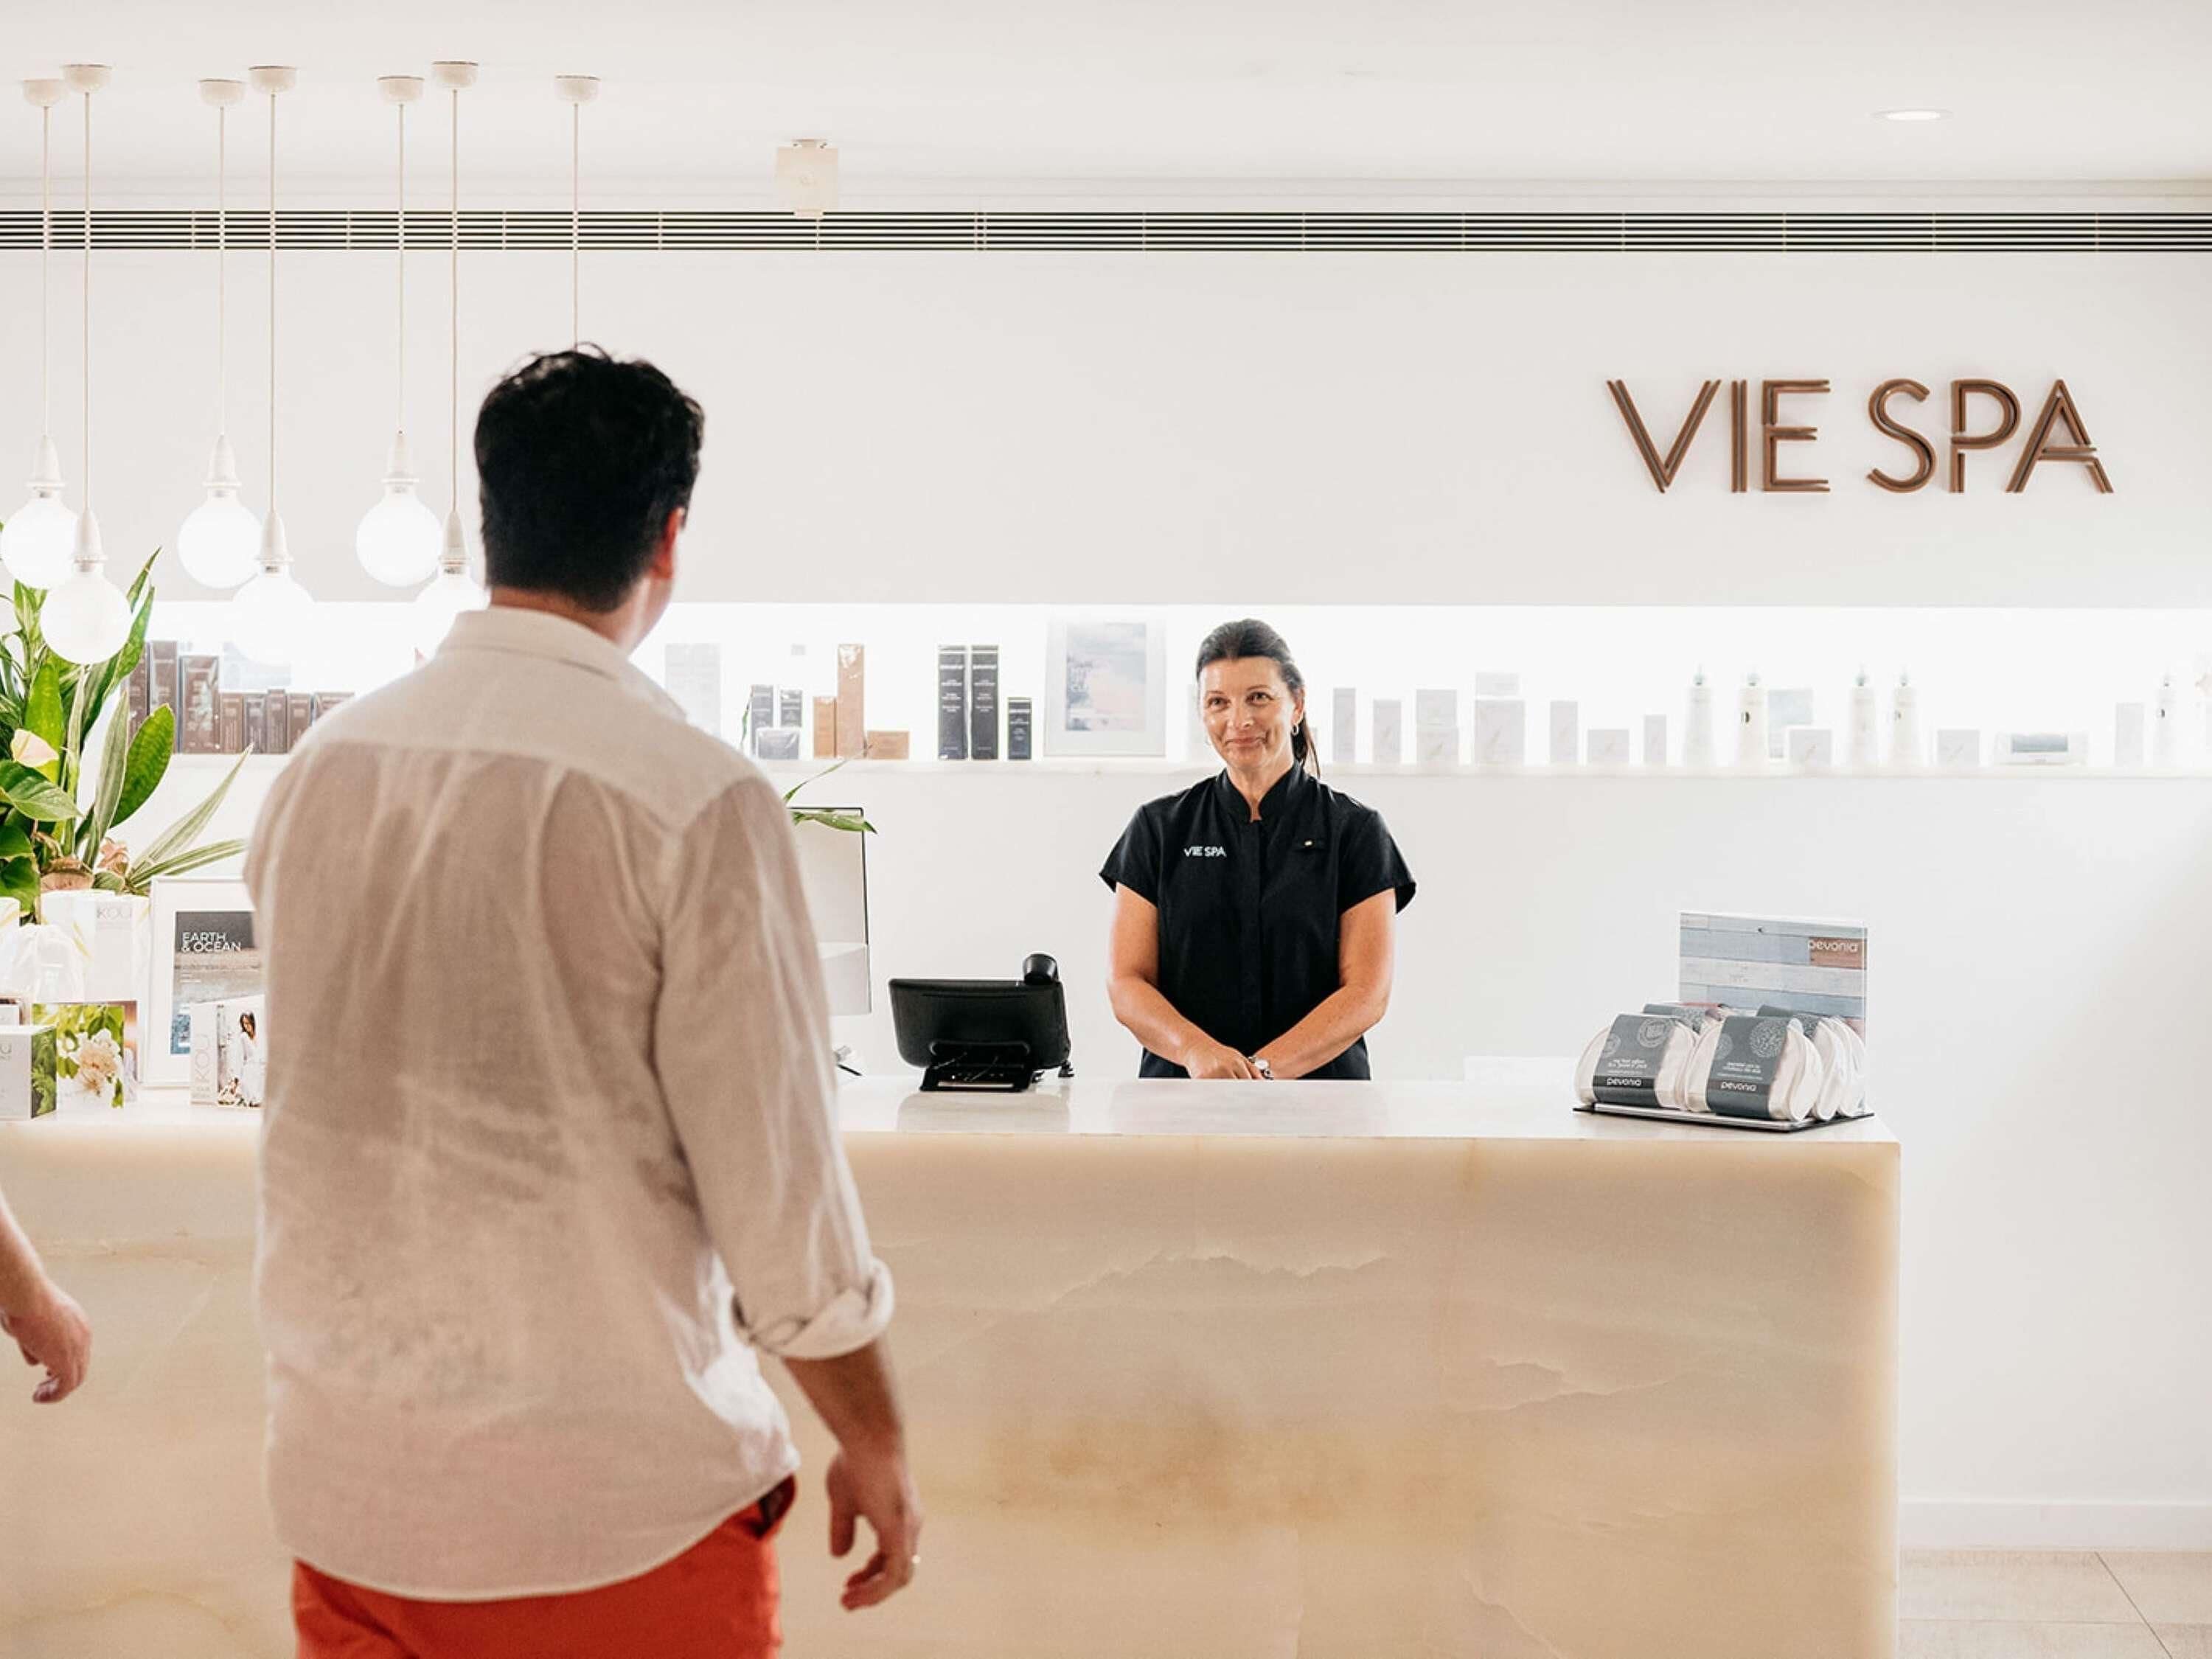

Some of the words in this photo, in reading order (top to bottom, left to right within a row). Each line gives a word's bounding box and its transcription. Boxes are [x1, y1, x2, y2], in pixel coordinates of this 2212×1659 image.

[1606, 378, 1831, 494] VIE
[1866, 378, 2114, 494] SPA
[1183, 846, 1203, 857] VIE
[1204, 846, 1227, 858] SPA
[182, 931, 226, 942] EARTH
[181, 942, 191, 953] &
[193, 941, 242, 953] OCEAN
[1807, 939, 1859, 953] pevonia
[1606, 1077, 1642, 1087] pevonia
[1720, 1081, 1757, 1092] pevonia
